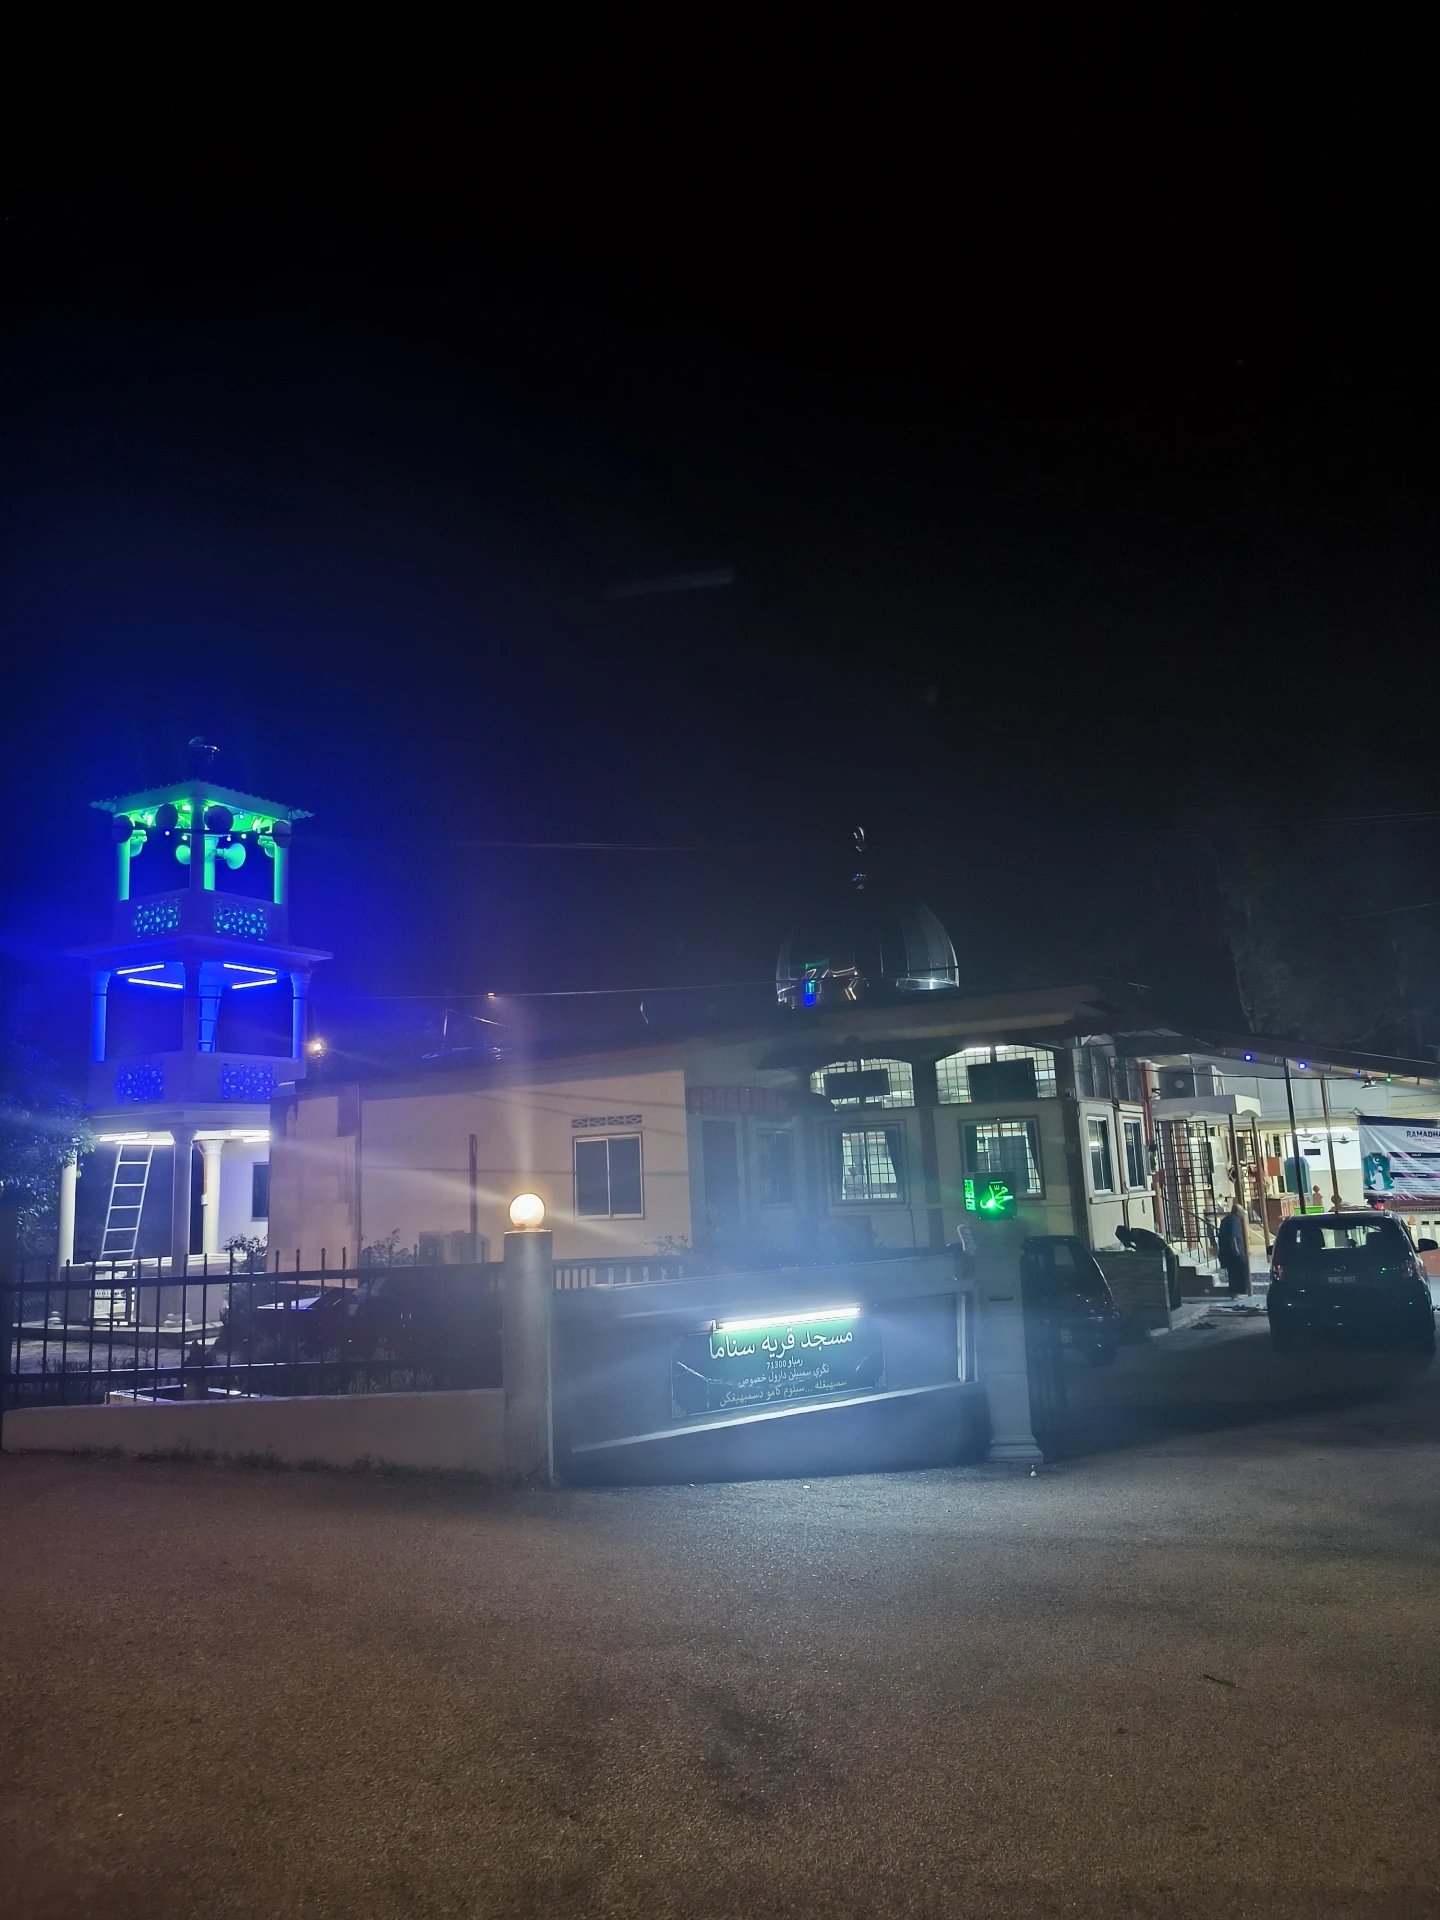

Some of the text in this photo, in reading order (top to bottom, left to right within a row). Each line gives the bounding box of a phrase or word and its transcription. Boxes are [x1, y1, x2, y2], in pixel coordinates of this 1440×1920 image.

[709, 1334, 756, 1359] سناما
[800, 1330, 853, 1351] مسجد
[766, 1360, 787, 1370] 71300
[768, 1370, 787, 1383] دارول
